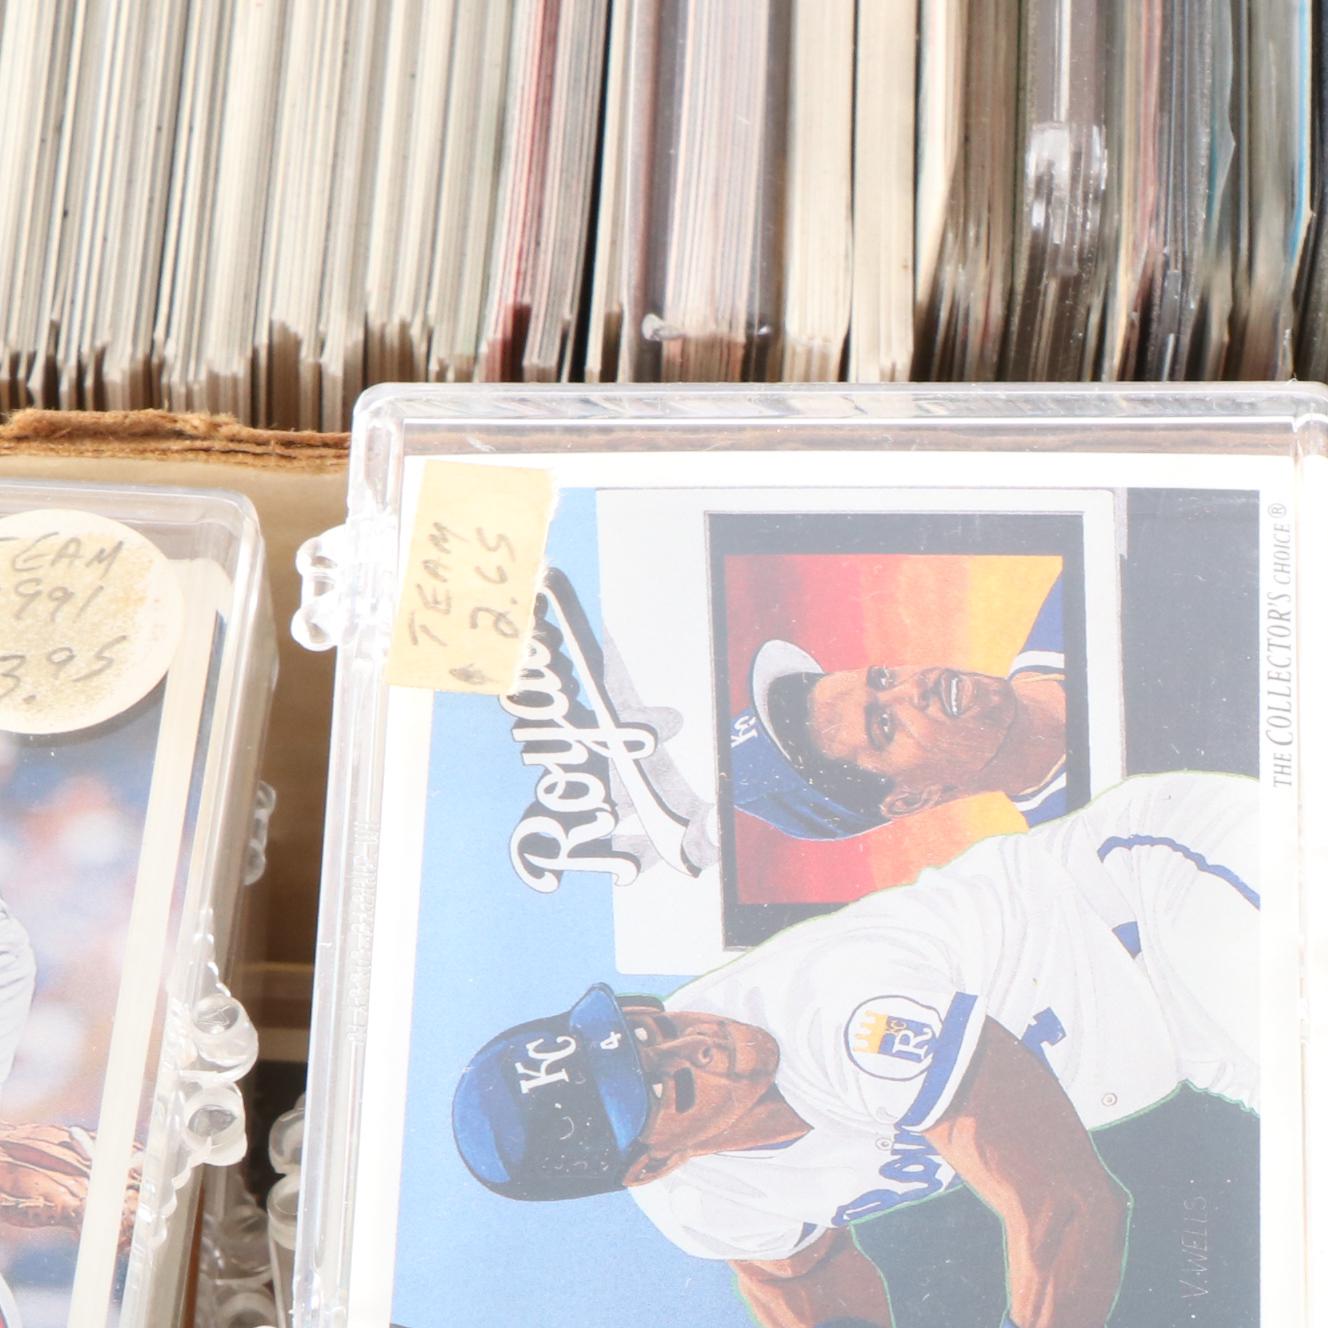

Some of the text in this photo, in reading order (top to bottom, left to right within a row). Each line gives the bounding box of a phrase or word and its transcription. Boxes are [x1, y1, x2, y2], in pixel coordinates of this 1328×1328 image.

[0, 577, 105, 624] 991
[407, 522, 470, 648] TEAM
[1265, 591, 1294, 747] COLLECTOR'S
[1273, 754, 1293, 788] THE
